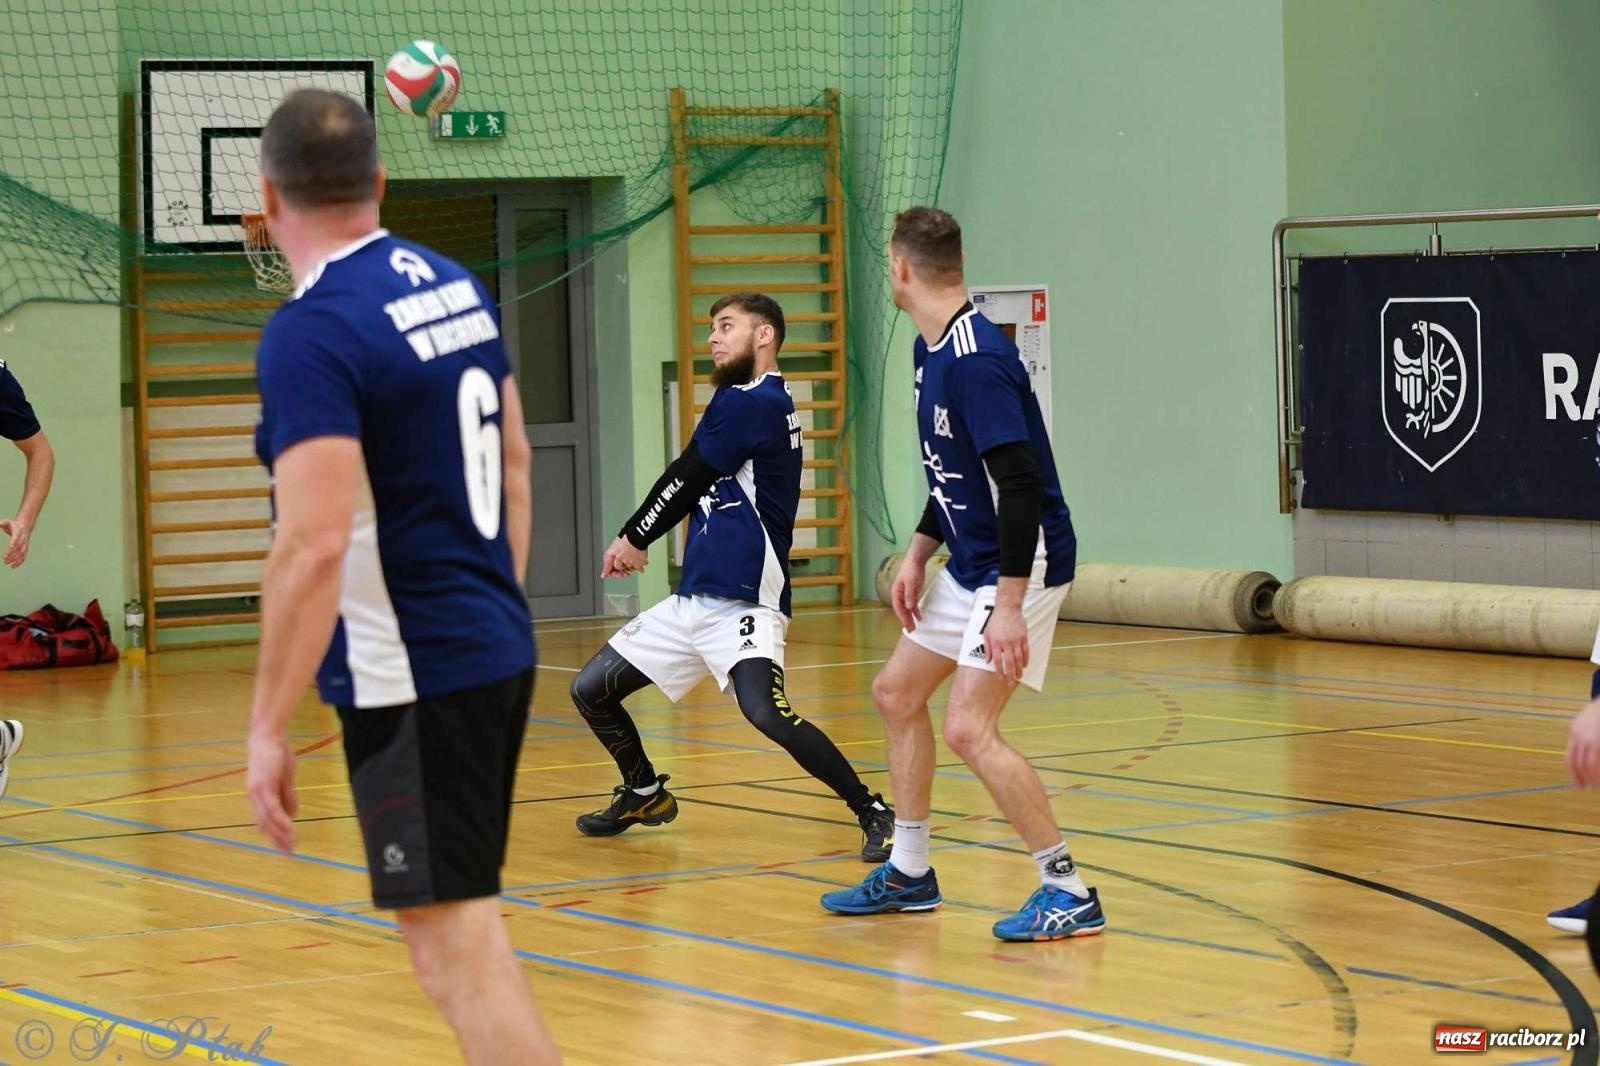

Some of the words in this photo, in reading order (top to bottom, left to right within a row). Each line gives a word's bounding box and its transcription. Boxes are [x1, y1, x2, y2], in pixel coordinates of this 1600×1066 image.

[457, 366, 502, 541] 6
[661, 477, 684, 501] WILL
[657, 497, 666, 508] I
[640, 508, 659, 531] CAN
[636, 526, 645, 537] I
[739, 615, 755, 637] 3
[980, 605, 995, 635] 7
